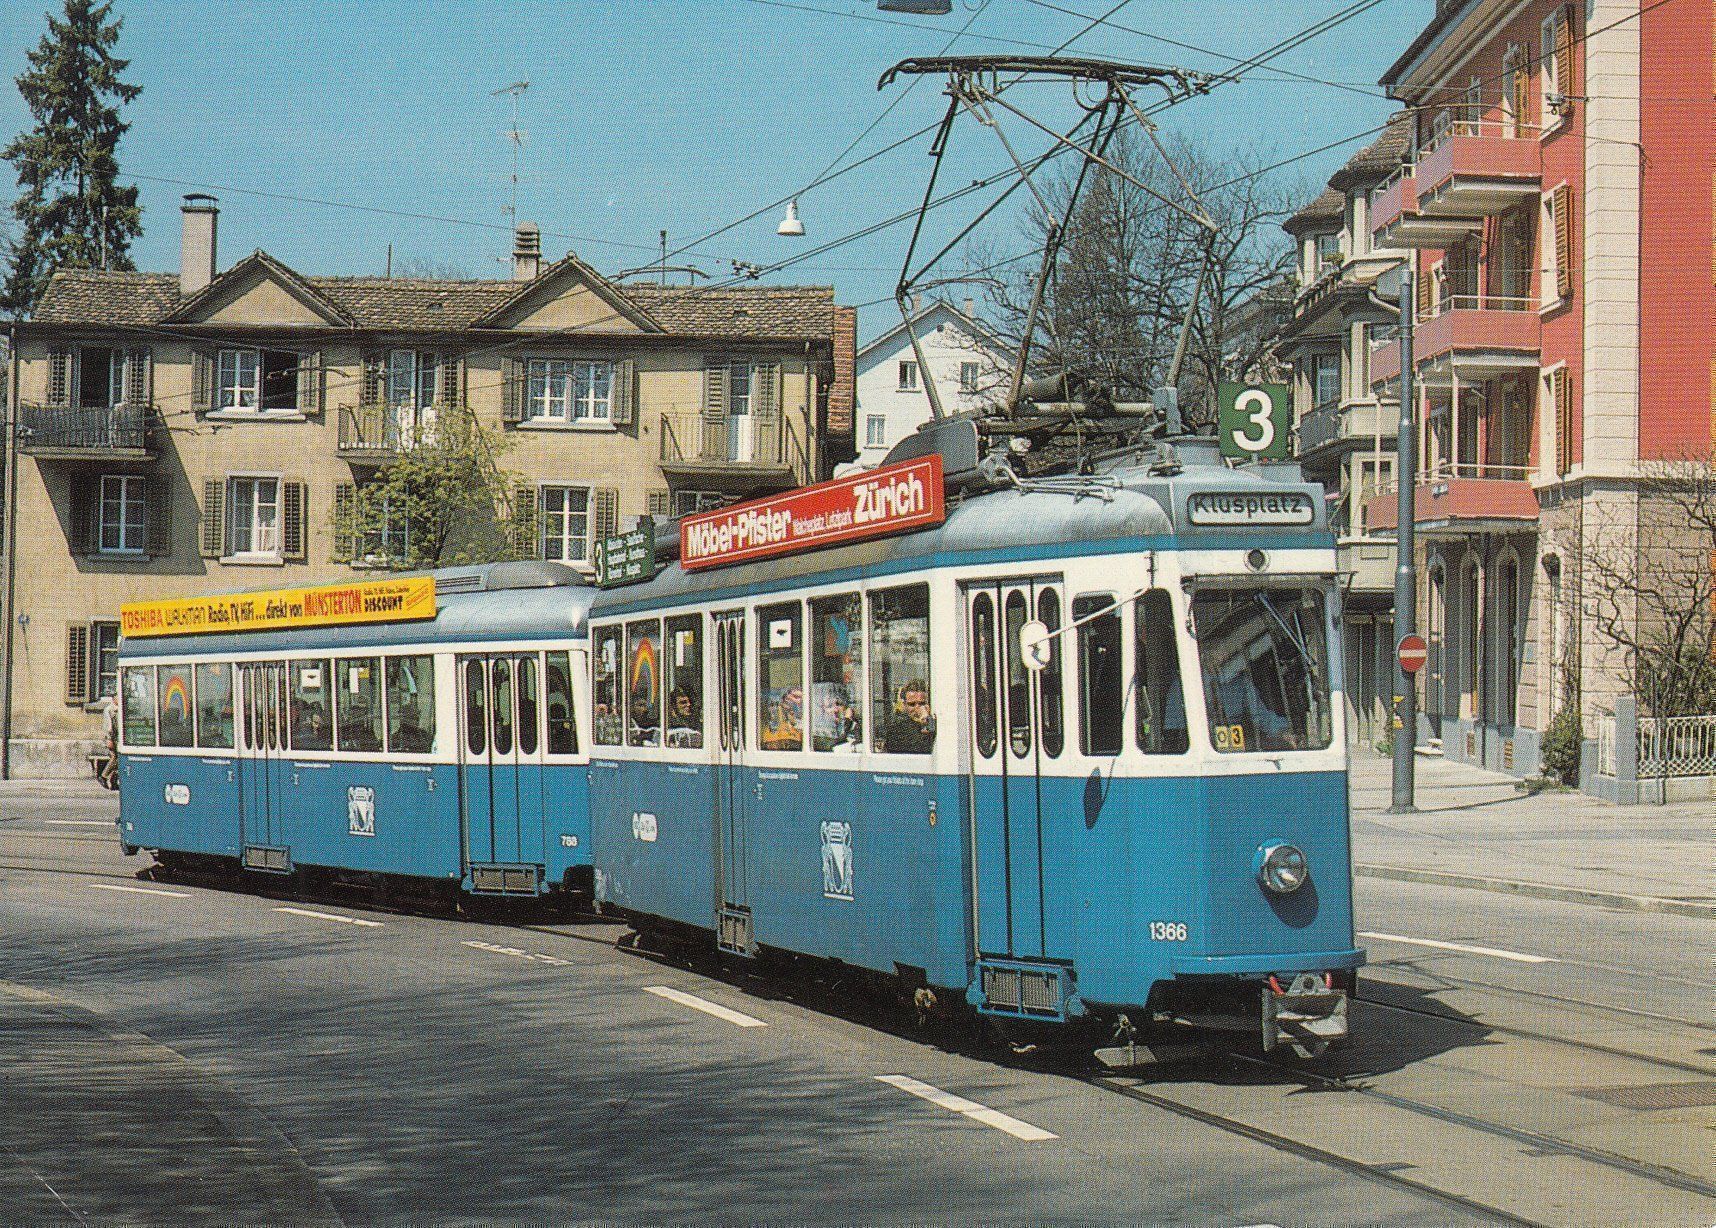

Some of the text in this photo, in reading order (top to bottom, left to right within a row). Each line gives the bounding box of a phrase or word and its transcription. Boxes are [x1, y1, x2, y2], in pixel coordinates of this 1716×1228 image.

[1231, 389, 1275, 451] 3
[687, 508, 792, 558] Möbel-Pfister
[853, 471, 924, 523] Zürich
[1194, 495, 1303, 519] Klusplatz
[595, 543, 604, 583] 3
[121, 608, 163, 629] TOSHIBA
[289, 601, 303, 618] von
[304, 589, 362, 616] MÜNSTERTON
[364, 595, 404, 613] DISCOUNT
[1149, 922, 1187, 941] 1366
